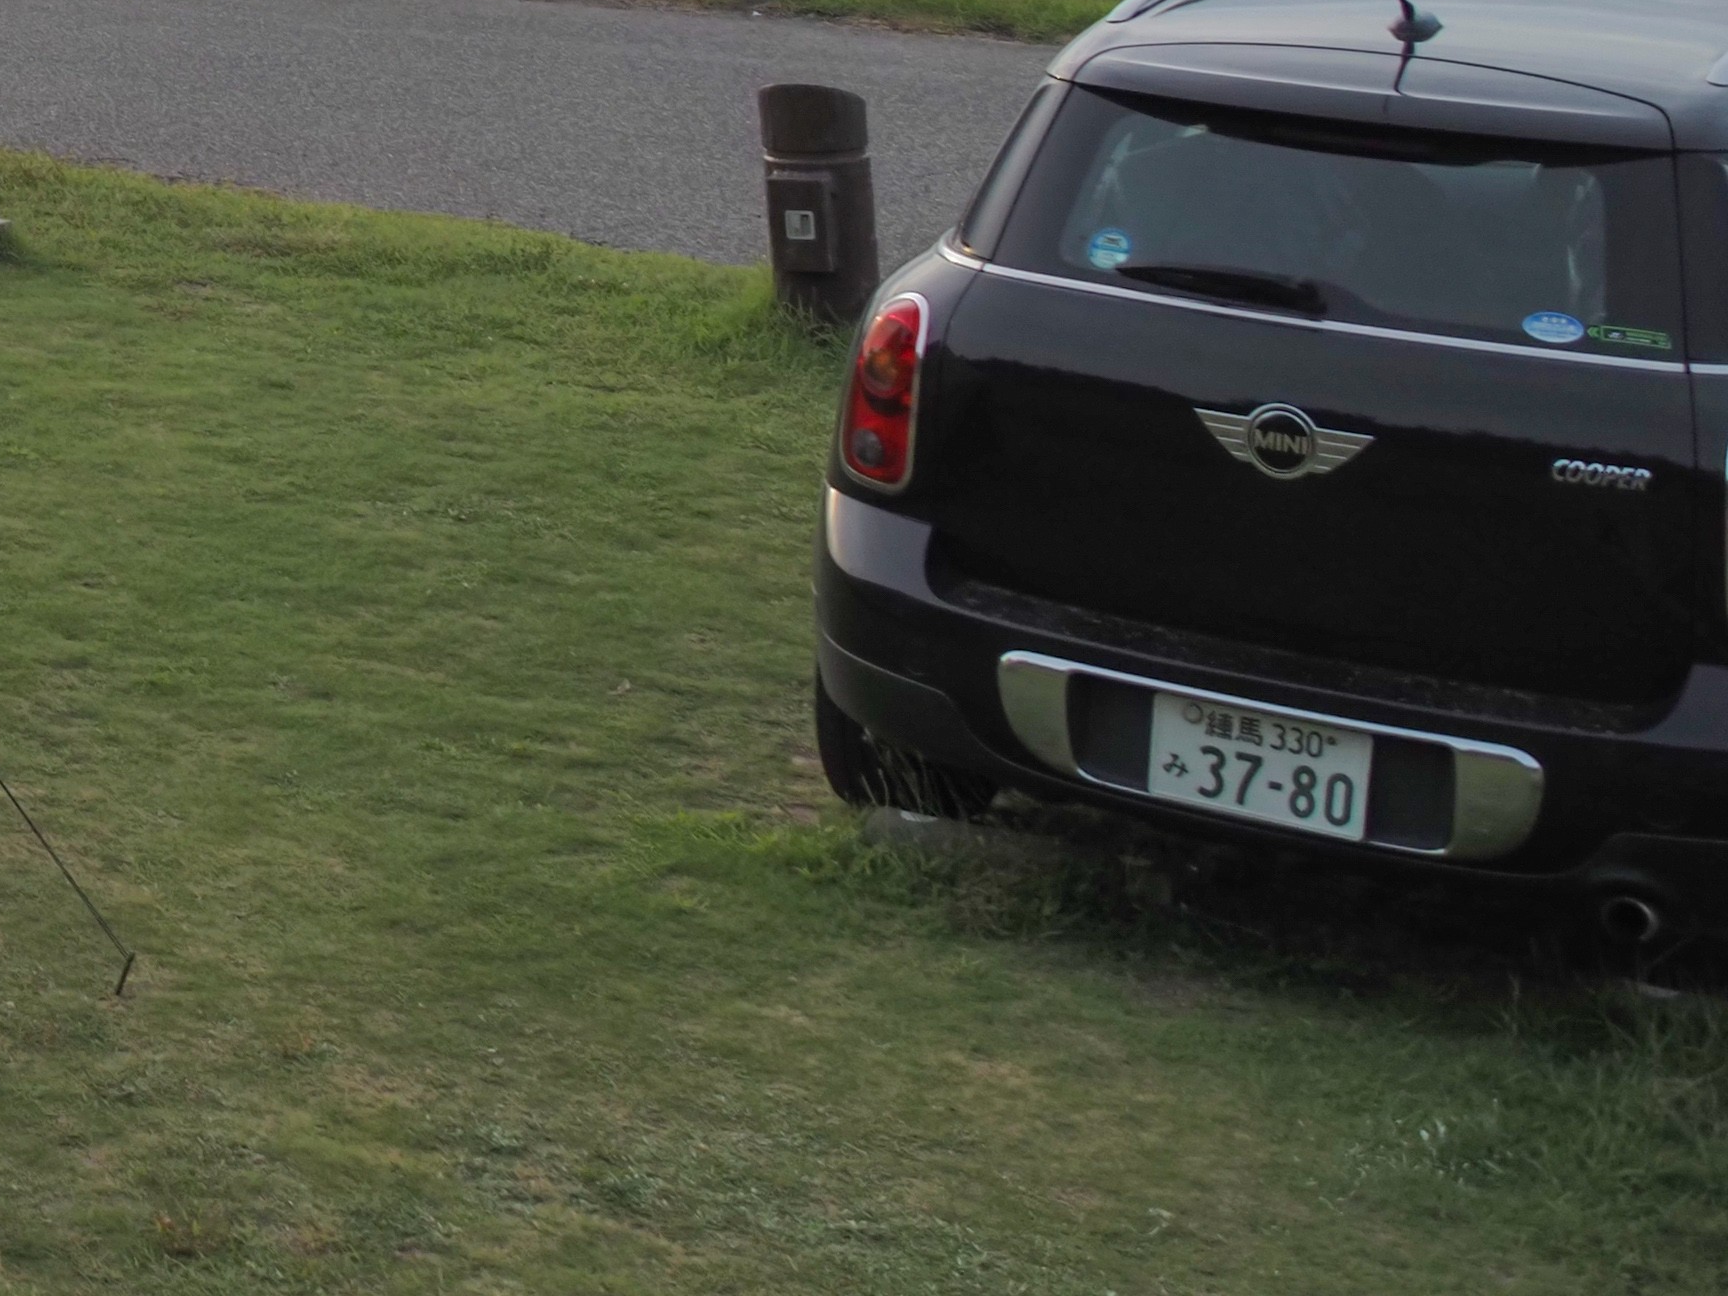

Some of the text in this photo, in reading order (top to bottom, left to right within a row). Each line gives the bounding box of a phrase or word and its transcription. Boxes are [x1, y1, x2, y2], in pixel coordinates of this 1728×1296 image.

[1254, 428, 1308, 455] MINI
[1551, 458, 1652, 491] COOPER
[1204, 711, 1323, 758] 練馬 330
[1162, 744, 1354, 826] み 37-80
